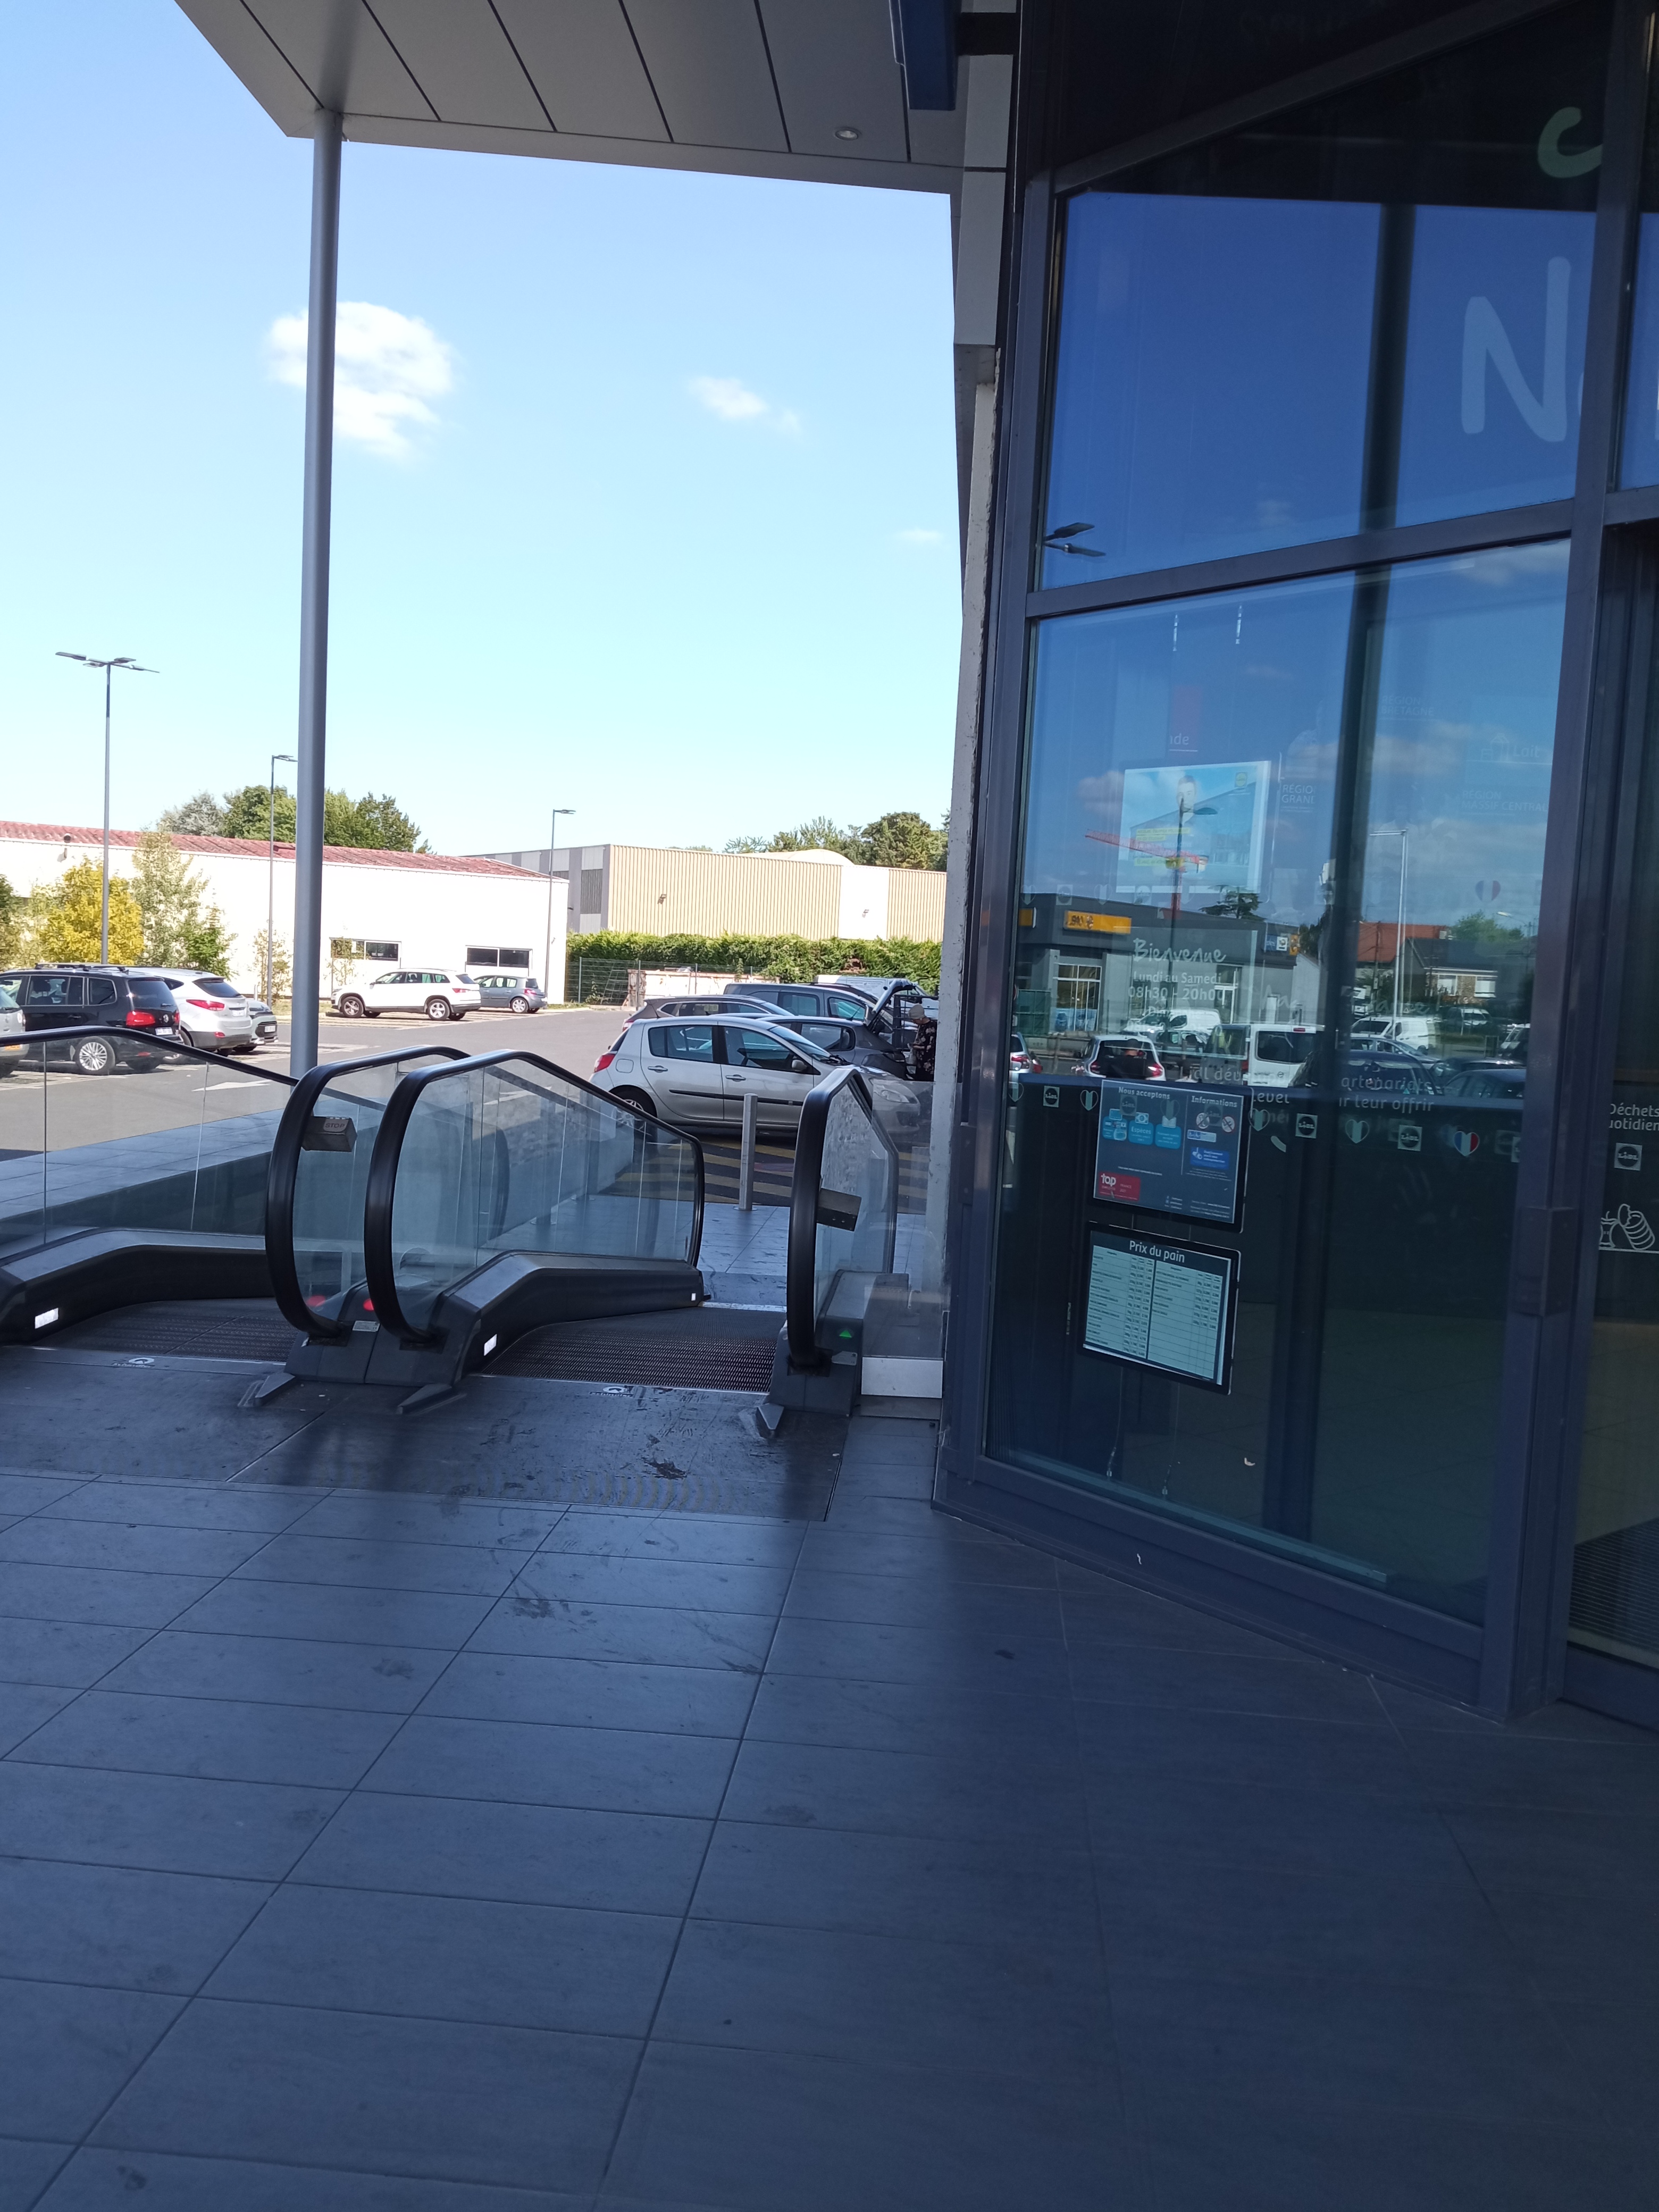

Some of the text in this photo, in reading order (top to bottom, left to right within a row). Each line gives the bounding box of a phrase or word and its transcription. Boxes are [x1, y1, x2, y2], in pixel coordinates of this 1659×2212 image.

[1461, 256, 1583, 441] N
[1282, 783, 1315, 794] RÉGIO
[1133, 937, 1226, 963] Bienvenue
[1134, 971, 1222, 984] Lundi au Samedi
[1128, 985, 1168, 999] 08h30
[1183, 988, 1225, 1001] 20h00
[1119, 1086, 1170, 1100] Nous acceptons
[1192, 1095, 1237, 1108] Informations
[1355, 1094, 1387, 1109] leur
[1392, 1097, 1435, 1114] offrir
[1131, 1126, 1152, 1135] Espèces
[1101, 1173, 1117, 1187] top
[1129, 1240, 1185, 1263] Prix du pain
